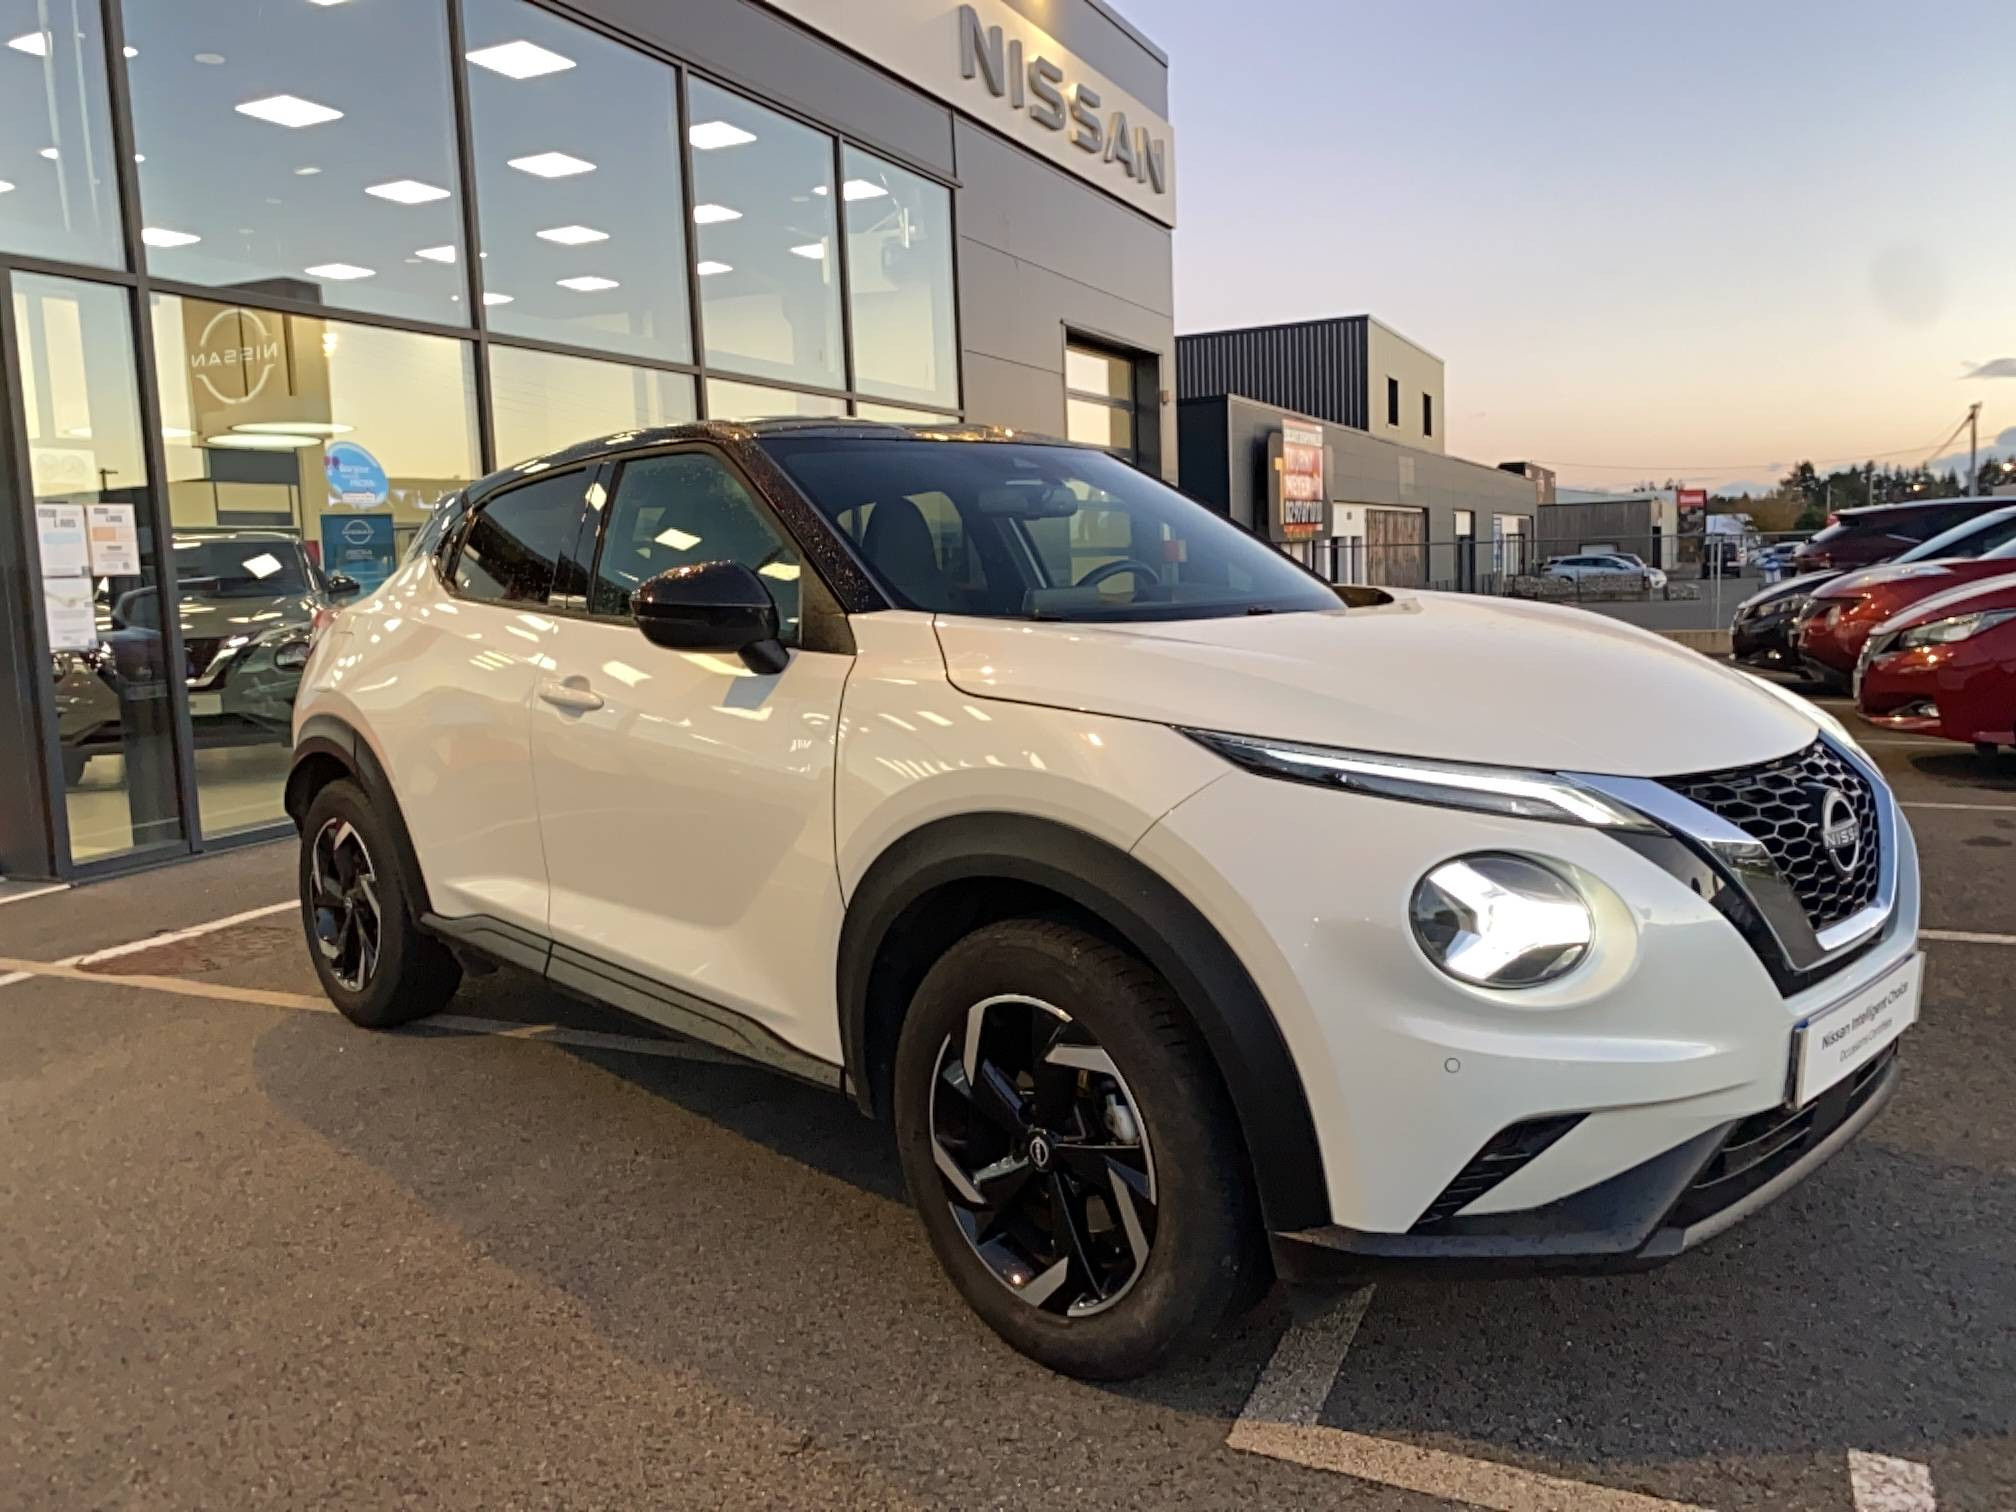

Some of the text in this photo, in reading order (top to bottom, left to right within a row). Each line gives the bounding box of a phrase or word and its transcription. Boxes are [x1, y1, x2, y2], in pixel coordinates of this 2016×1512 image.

[958, 4, 1165, 194] NISSAN
[1823, 823, 1859, 849] NISS
[1822, 1023, 1851, 1050] Nissan
